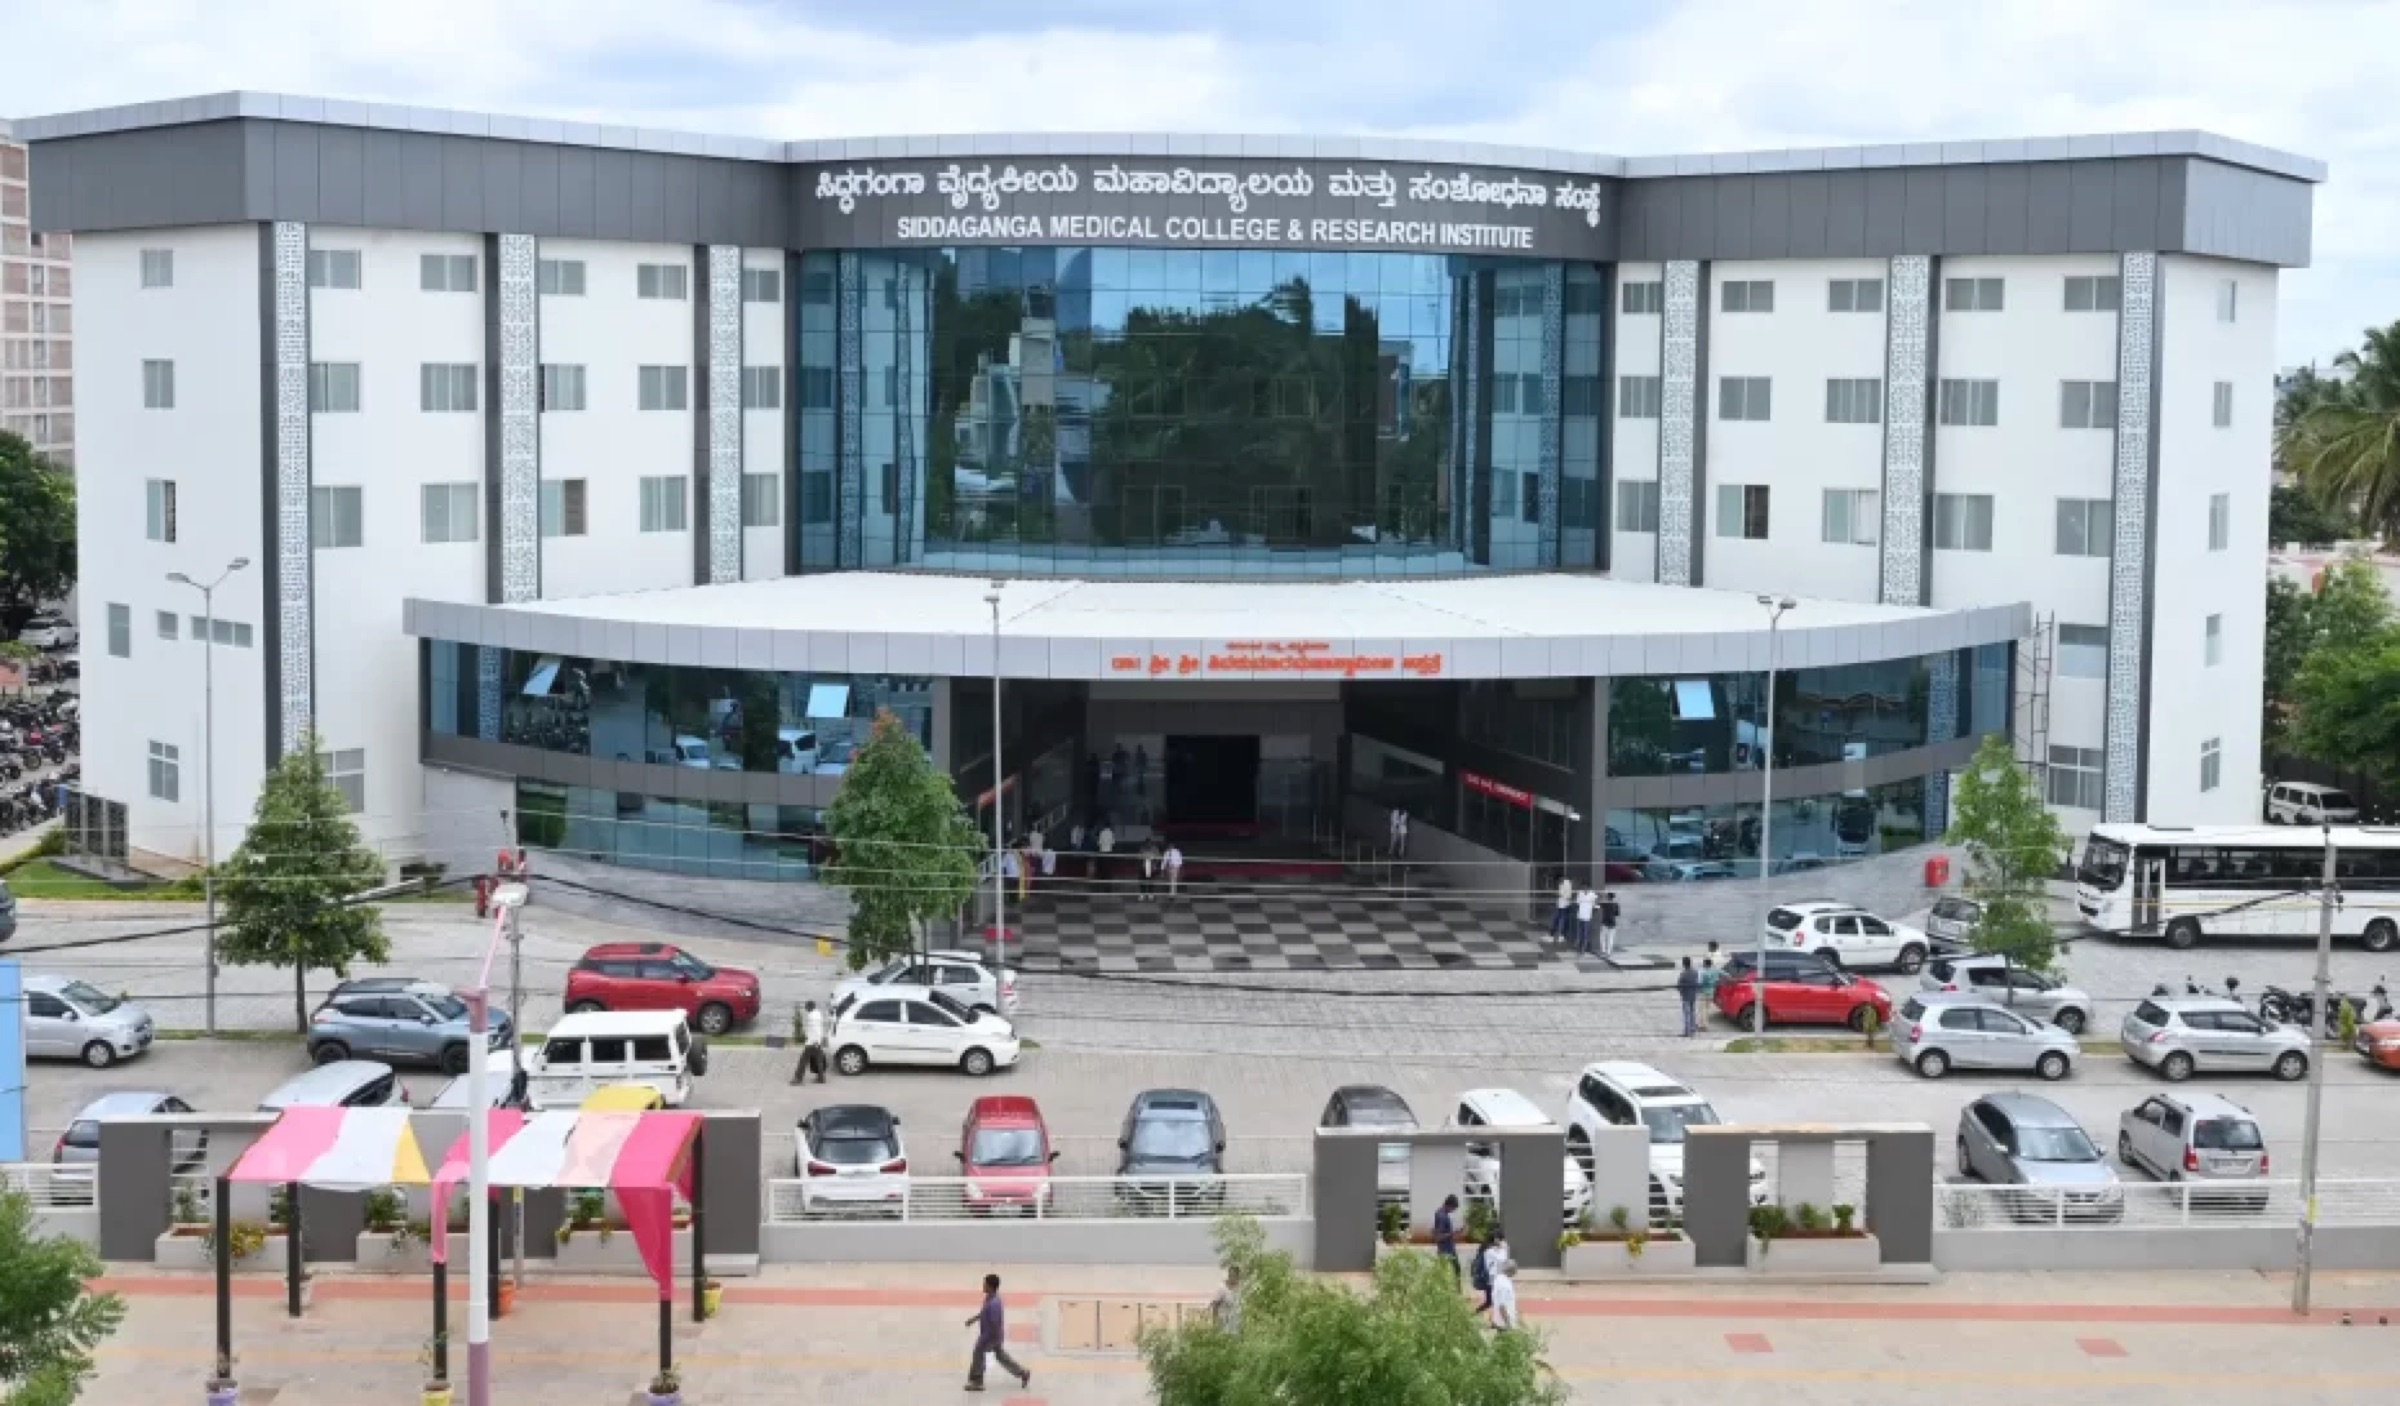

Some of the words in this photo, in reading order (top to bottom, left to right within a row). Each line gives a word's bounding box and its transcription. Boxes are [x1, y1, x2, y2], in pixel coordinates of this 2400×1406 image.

[937, 164, 1077, 211] ವೈದ್ಯಕೀಯ
[1093, 163, 1313, 213] ಮಹಾವಿದ್ಯಾಲಯ
[1329, 167, 1396, 207] ಮತ್ತು
[1408, 170, 1548, 209] ಸಂಶೋಧನಾ
[1555, 181, 1601, 227] ಸಂಸ್ಥೆ
[897, 216, 1043, 239] SIDDAGANGA
[1050, 216, 1159, 238] MEDICAL
[1165, 216, 1281, 241] COLLEGE
[1287, 218, 1304, 241] &
[1310, 219, 1436, 244] RESEARCH
[1439, 222, 1534, 248] INSTITUTE
